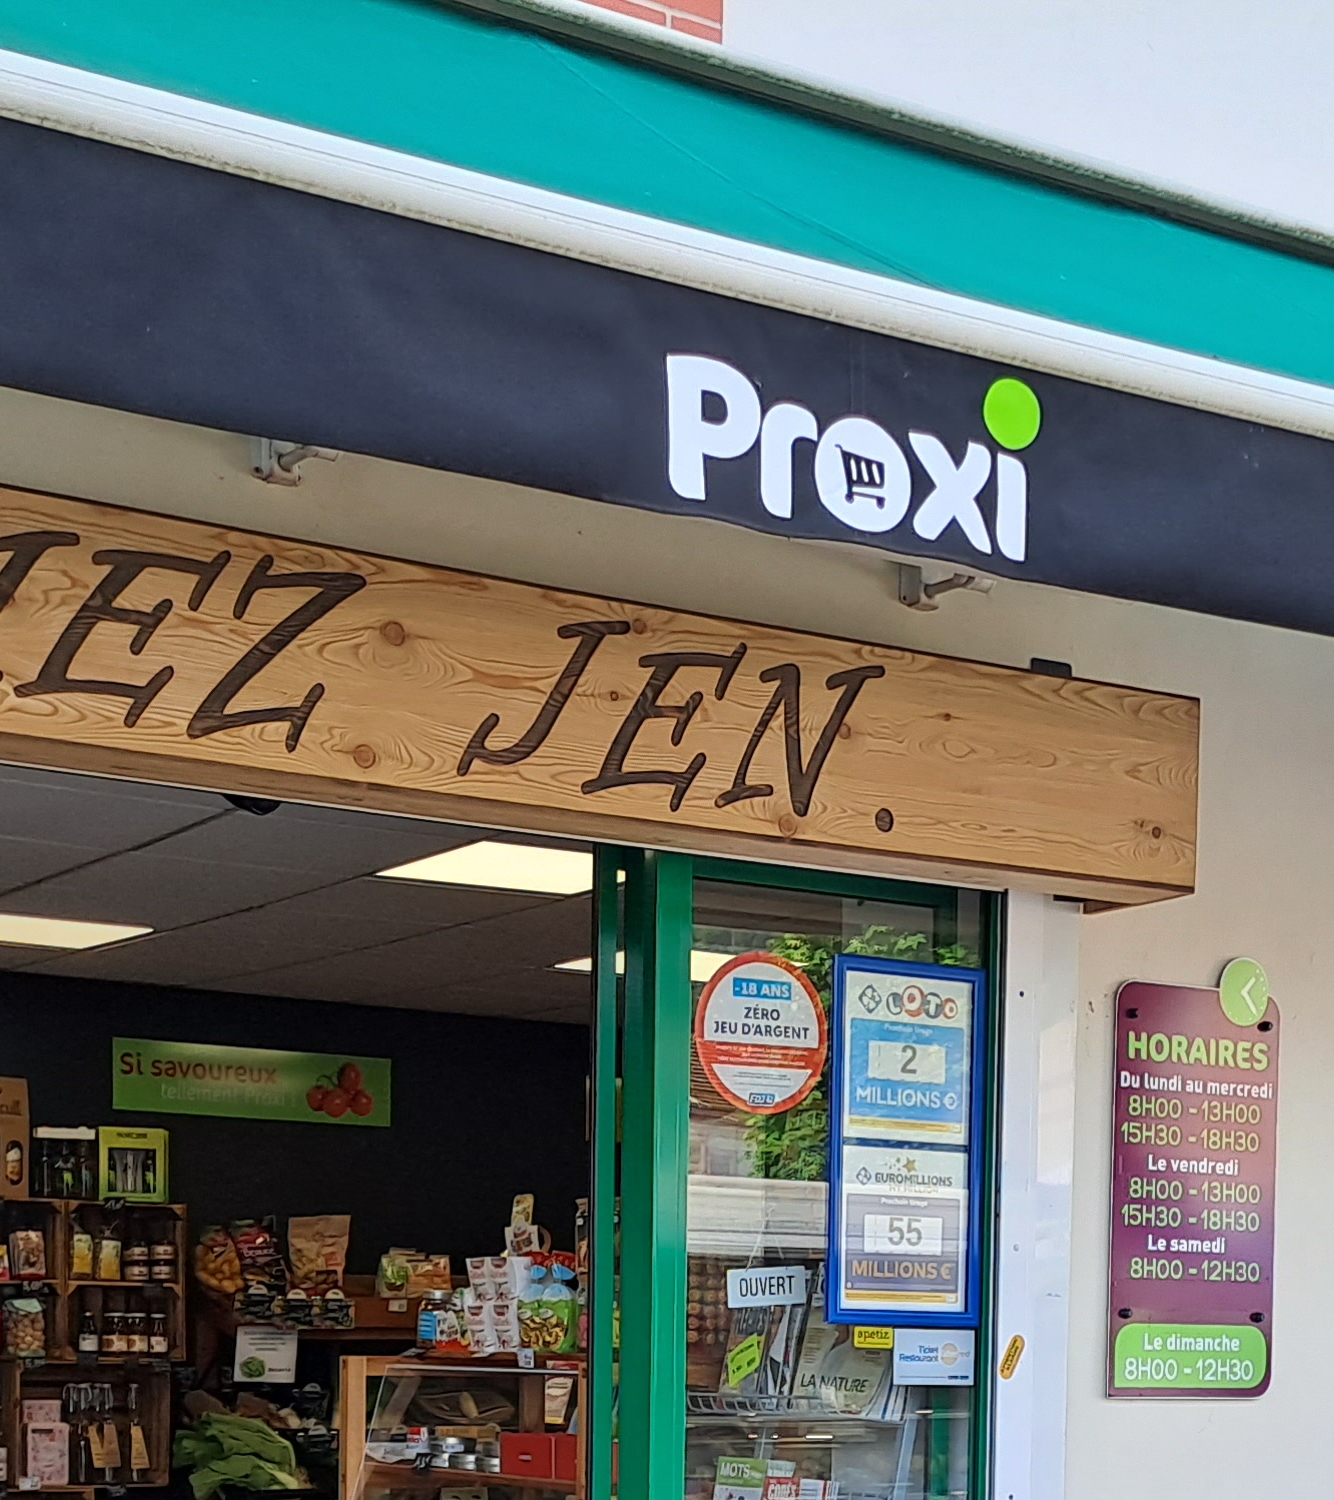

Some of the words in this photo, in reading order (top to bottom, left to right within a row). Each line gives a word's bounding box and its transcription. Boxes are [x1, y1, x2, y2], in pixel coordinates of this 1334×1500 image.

[665, 353, 1041, 562] Proxi
[760, 984, 790, 998] ANS
[886, 985, 958, 1020] LOTO
[744, 1004, 780, 1021] ZÉRO
[714, 1021, 738, 1034] JEU
[741, 1023, 809, 1040] D'ARGENT
[901, 1045, 917, 1074] 2
[1128, 1030, 1269, 1071] HORAIRES
[120, 1052, 143, 1075] Si
[150, 1059, 276, 1084] savoureux
[1120, 1071, 1140, 1089] Du
[1145, 1073, 1182, 1092] lundi
[1186, 1080, 1203, 1093] au
[1207, 1083, 1272, 1099] mercredi
[856, 1086, 941, 1109] MILLIONS
[1128, 1095, 1182, 1119] 8H00
[1201, 1100, 1261, 1124] 13H00
[1120, 1121, 1181, 1146] 15H30
[1200, 1128, 1260, 1152] 18H30
[1147, 1154, 1166, 1171] Le
[1170, 1157, 1239, 1176] vendredi
[875, 1172, 952, 1187] EUROMILLIONS
[1129, 1177, 1183, 1201] 8H00
[1202, 1181, 1261, 1204] 13H00
[1121, 1203, 1181, 1228] 15H30
[1201, 1209, 1260, 1231] 18H30
[888, 1217, 922, 1246] 55
[1148, 1234, 1166, 1251] Le
[1169, 1237, 1225, 1254] samedi
[852, 1260, 937, 1280] MILLIONS
[1130, 1257, 1183, 1279] 8H00
[1201, 1260, 1260, 1282] 12H30
[739, 1276, 795, 1297] OUVERT
[1144, 1333, 1162, 1350] Le
[1167, 1334, 1240, 1351] dimanche
[1124, 1358, 1177, 1381] 8H00
[1196, 1359, 1253, 1381] 12H30
[801, 1374, 816, 1387] LA
[820, 1375, 869, 1393] NATURE
[720, 1462, 750, 1479] MOTS
